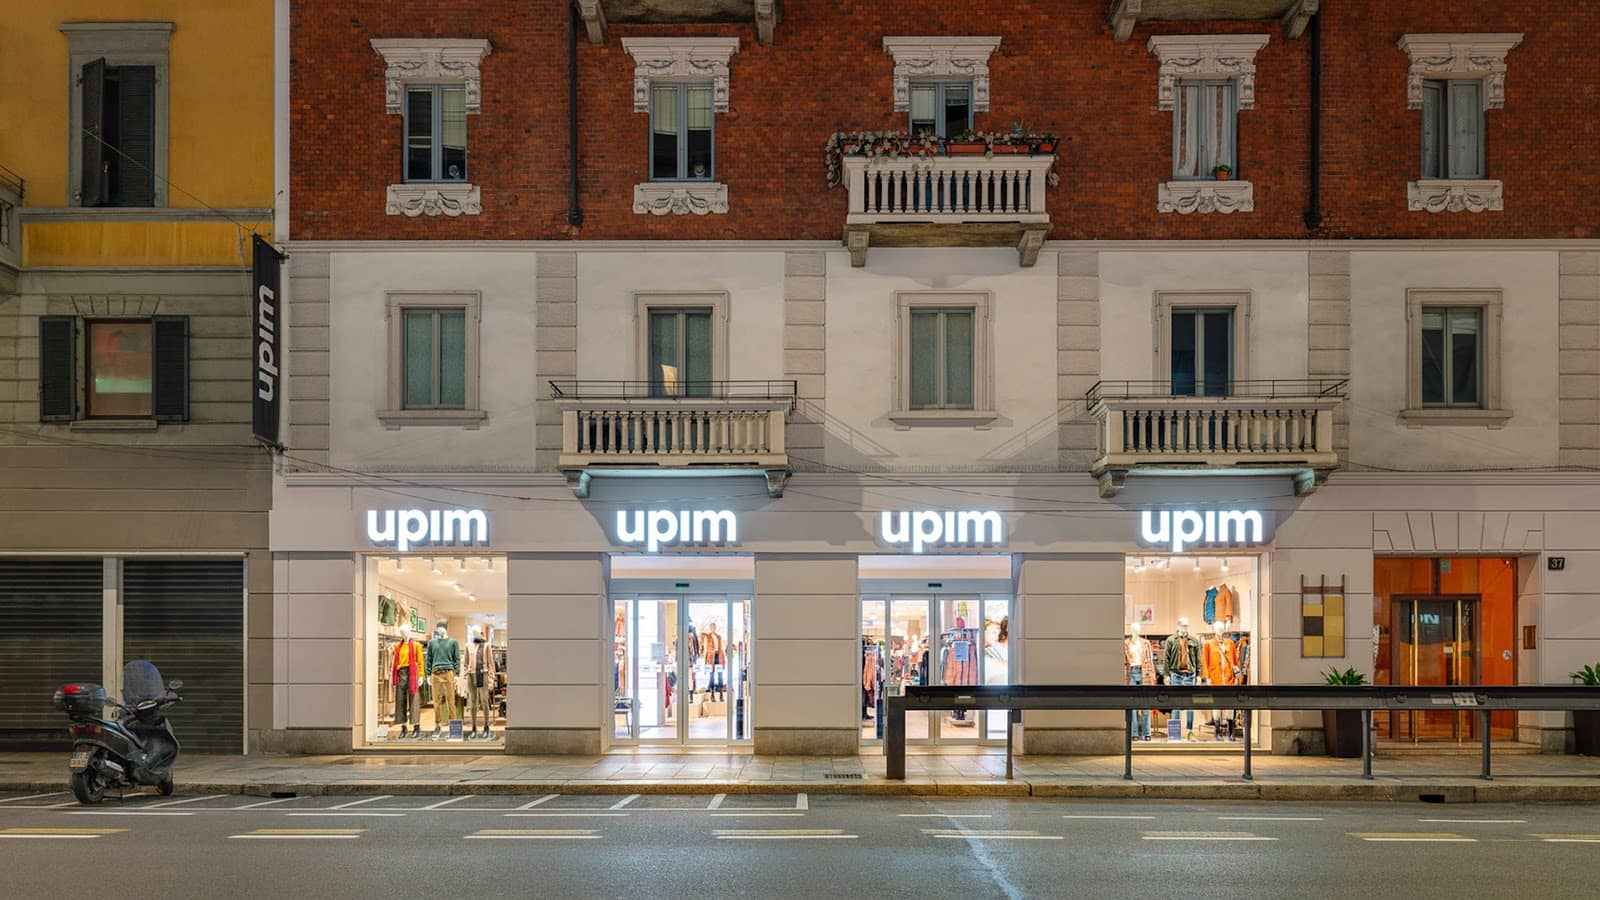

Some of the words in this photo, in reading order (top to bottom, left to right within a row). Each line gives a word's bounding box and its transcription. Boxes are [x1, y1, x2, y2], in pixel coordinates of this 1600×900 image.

[258, 284, 278, 402] upim
[367, 509, 487, 552] upim
[617, 510, 737, 552] upim
[882, 510, 1002, 553] upim
[1142, 510, 1262, 553] upim
[1551, 558, 1563, 569] 37
